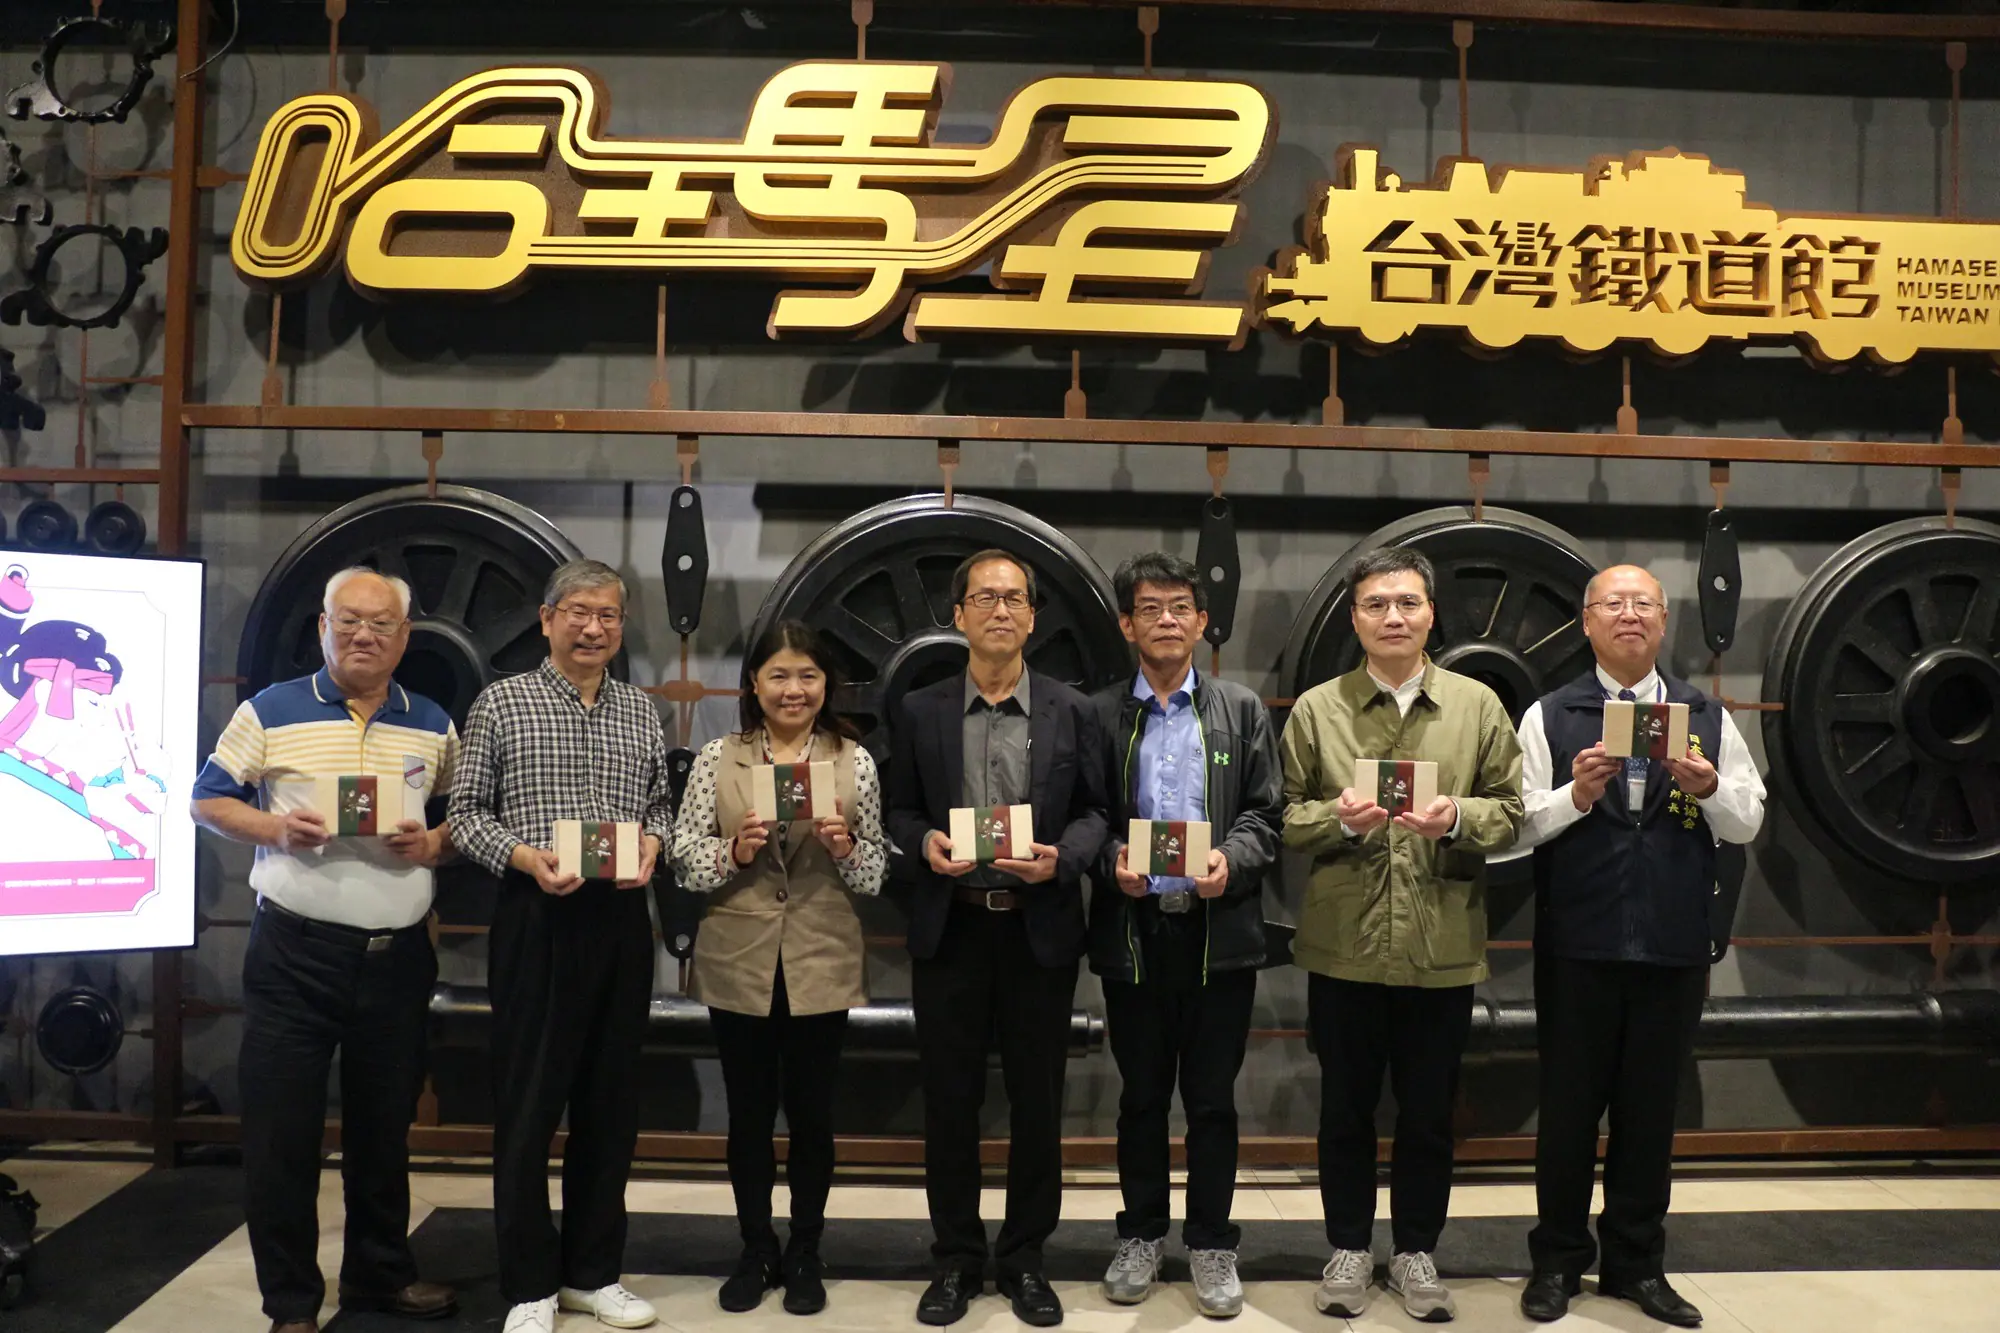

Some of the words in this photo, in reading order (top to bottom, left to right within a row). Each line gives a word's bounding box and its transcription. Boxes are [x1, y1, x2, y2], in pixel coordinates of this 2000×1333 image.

[231, 62, 1268, 338] 哈瑪星
[1362, 217, 1882, 320] 台灣鐵道館
[1897, 257, 1997, 276] HAMASE
[1897, 281, 2000, 300] MUSEUM
[1896, 305, 1989, 324] TAIWAN
